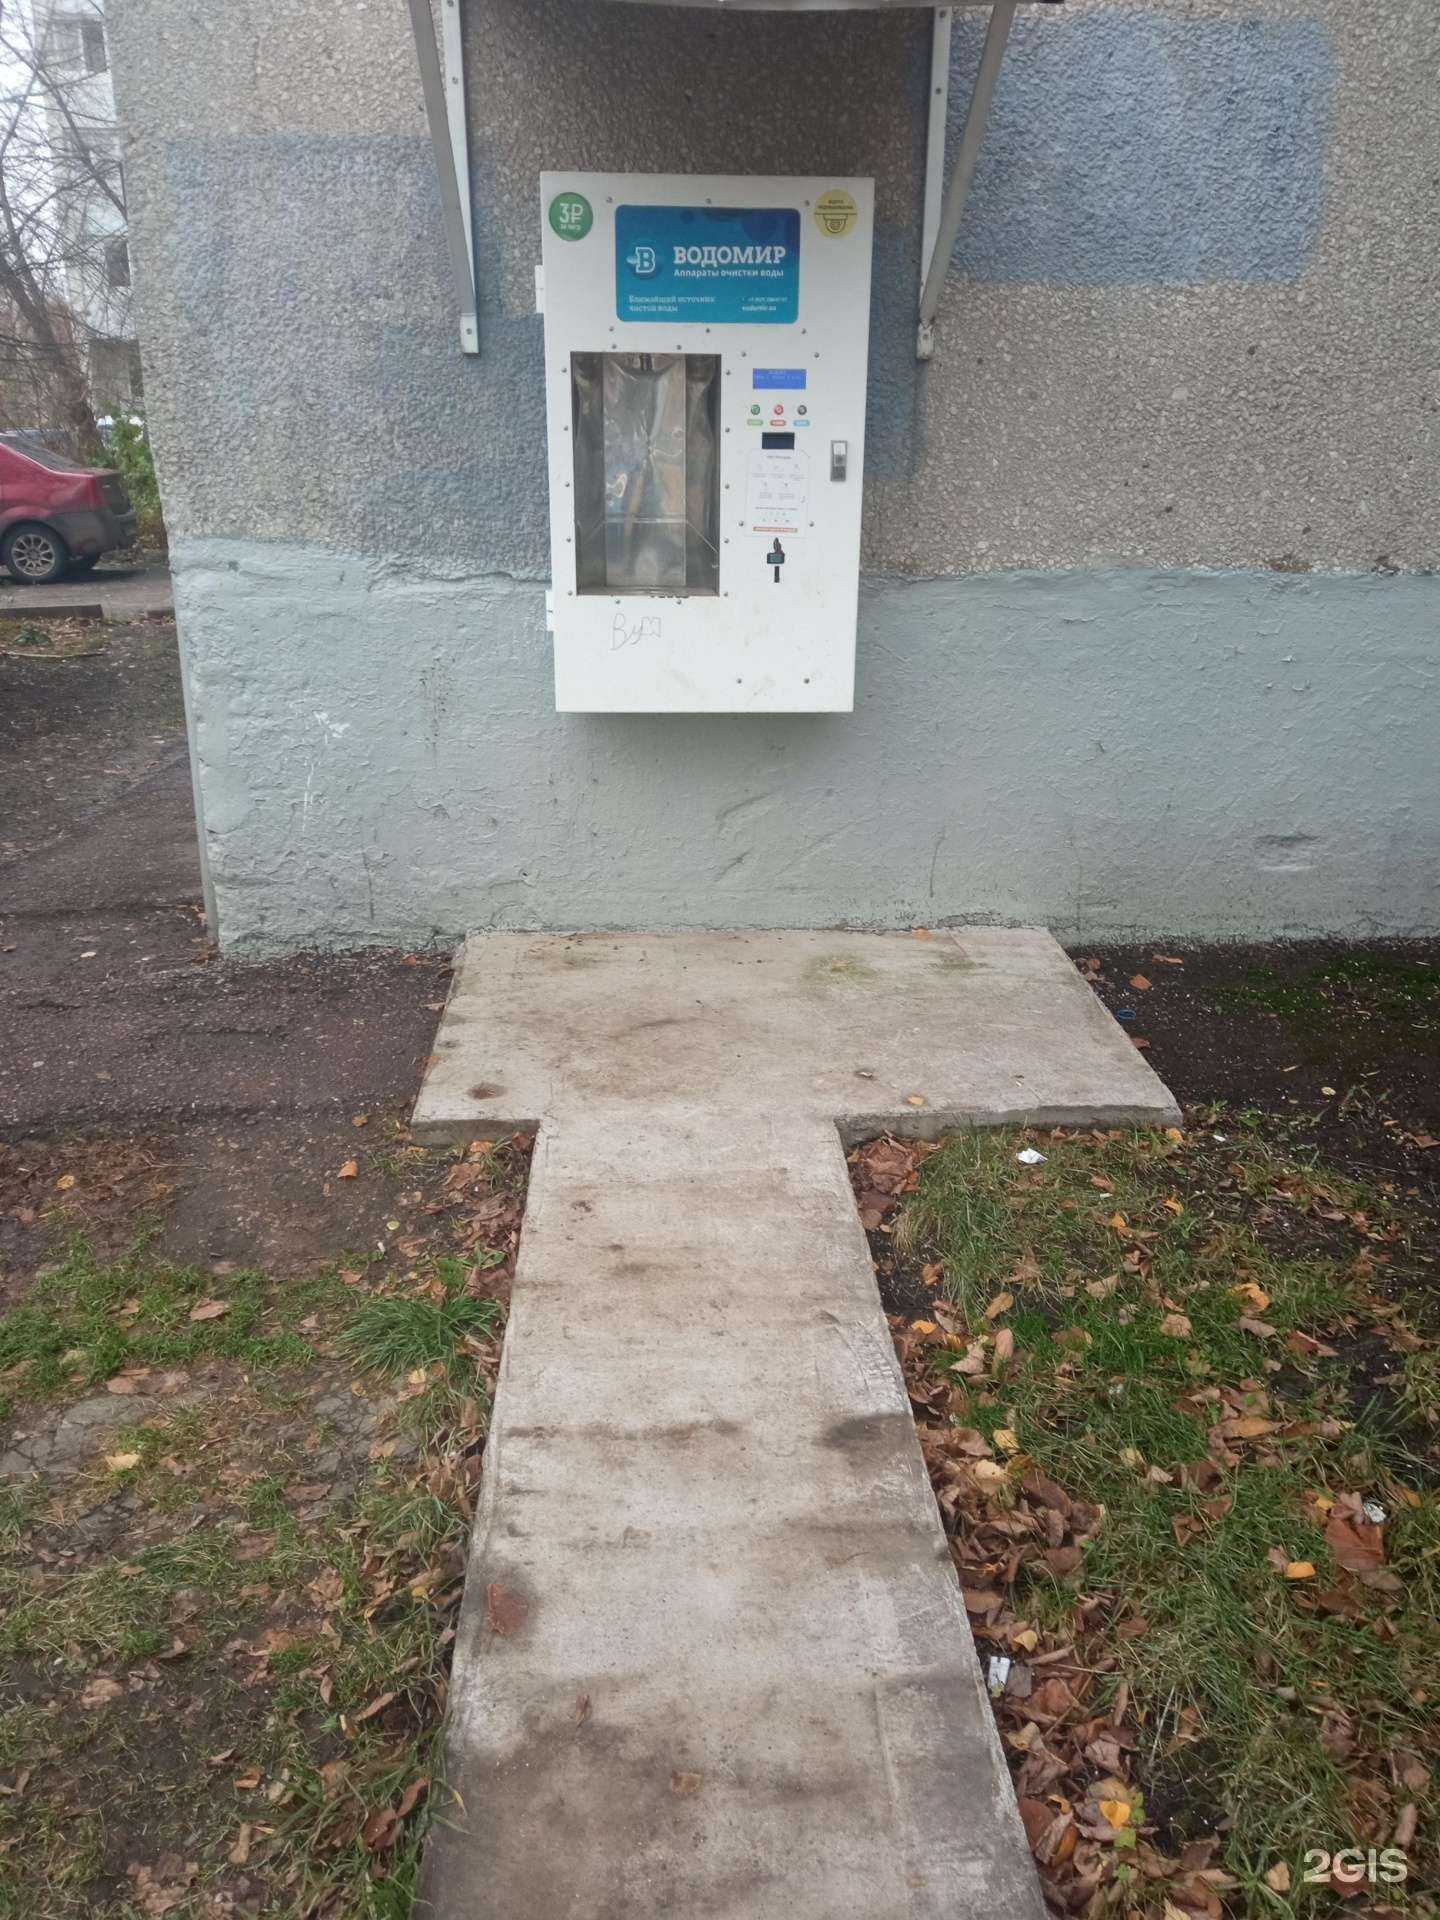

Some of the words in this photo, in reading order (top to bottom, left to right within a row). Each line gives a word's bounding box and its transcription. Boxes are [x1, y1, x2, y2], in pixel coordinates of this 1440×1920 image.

[673, 246, 786, 268] ВОДОМИР
[673, 269, 720, 279] Аппараты
[760, 270, 784, 279] воды
